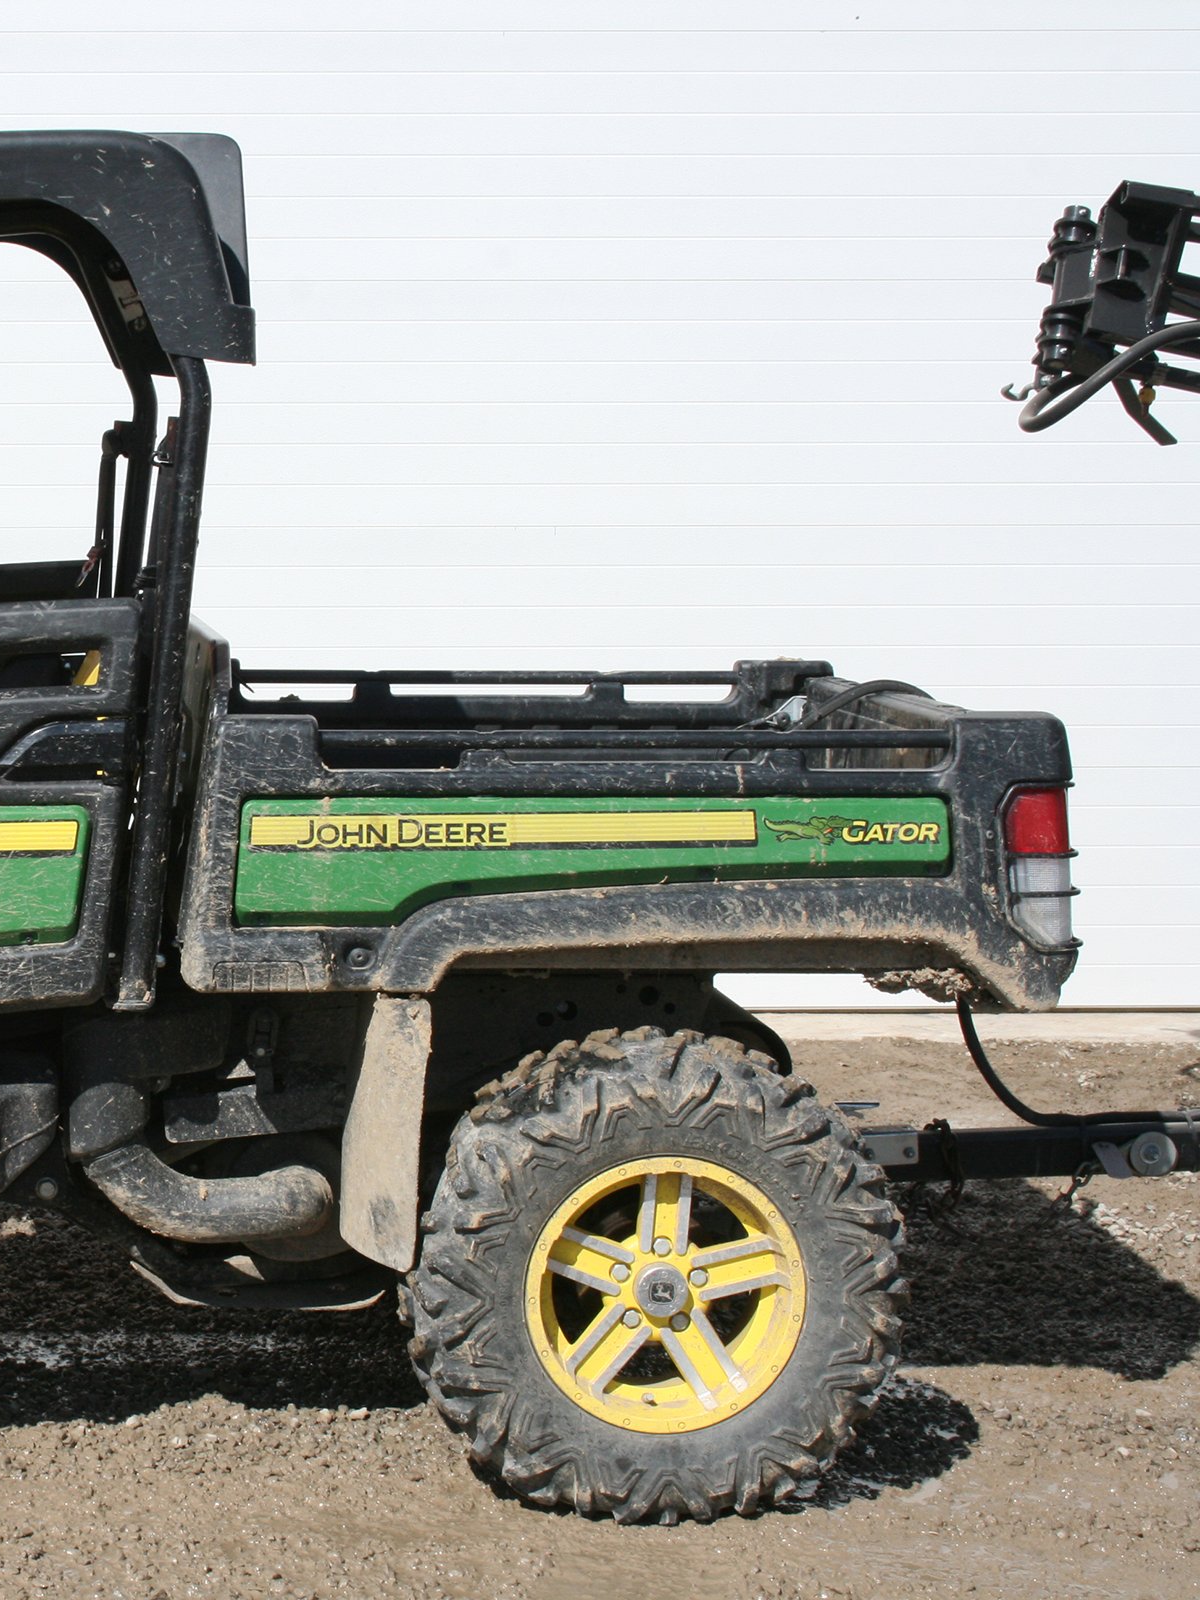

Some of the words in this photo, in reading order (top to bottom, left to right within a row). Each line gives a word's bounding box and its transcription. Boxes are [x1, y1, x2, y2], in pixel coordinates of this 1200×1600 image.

[296, 819, 388, 845] JOHN
[397, 818, 508, 844] DEERE
[841, 820, 941, 844] GATOR
